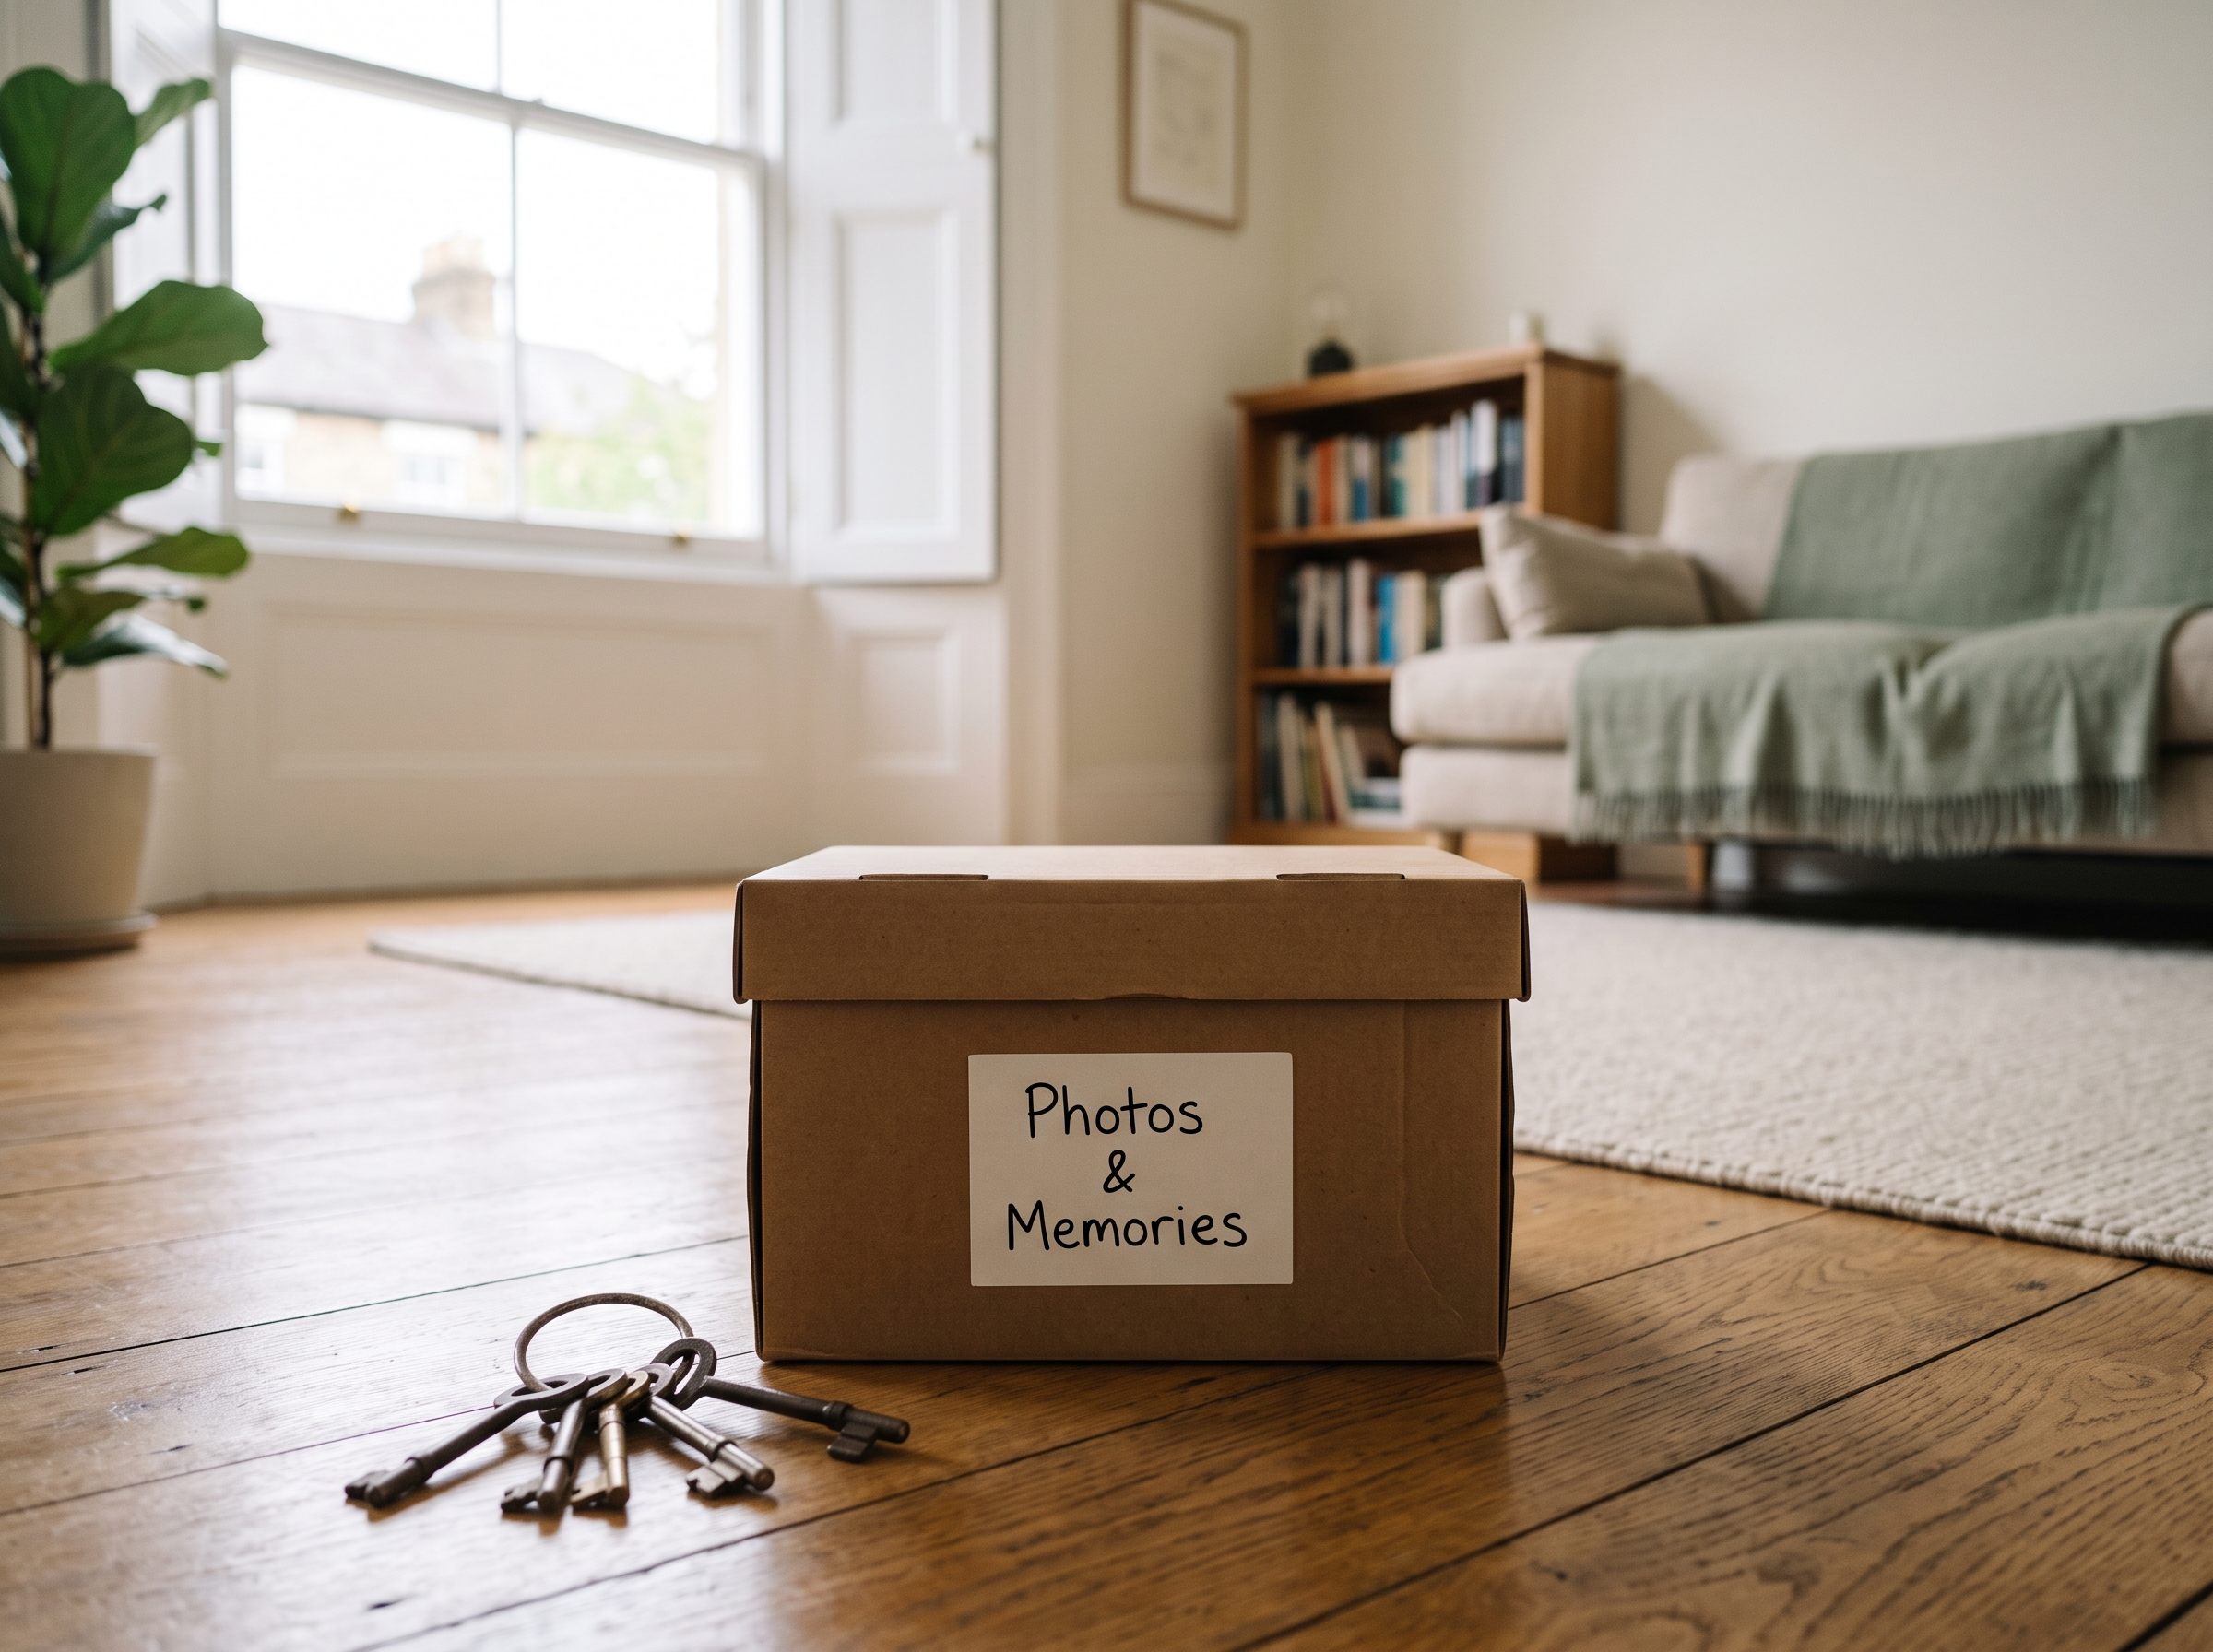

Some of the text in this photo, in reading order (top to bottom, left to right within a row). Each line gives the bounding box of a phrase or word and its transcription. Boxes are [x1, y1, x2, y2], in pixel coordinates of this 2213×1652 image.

[1024, 1081, 1204, 1139] Photos
[1102, 1149, 1136, 1194] &
[1007, 1199, 1249, 1251] Memories
